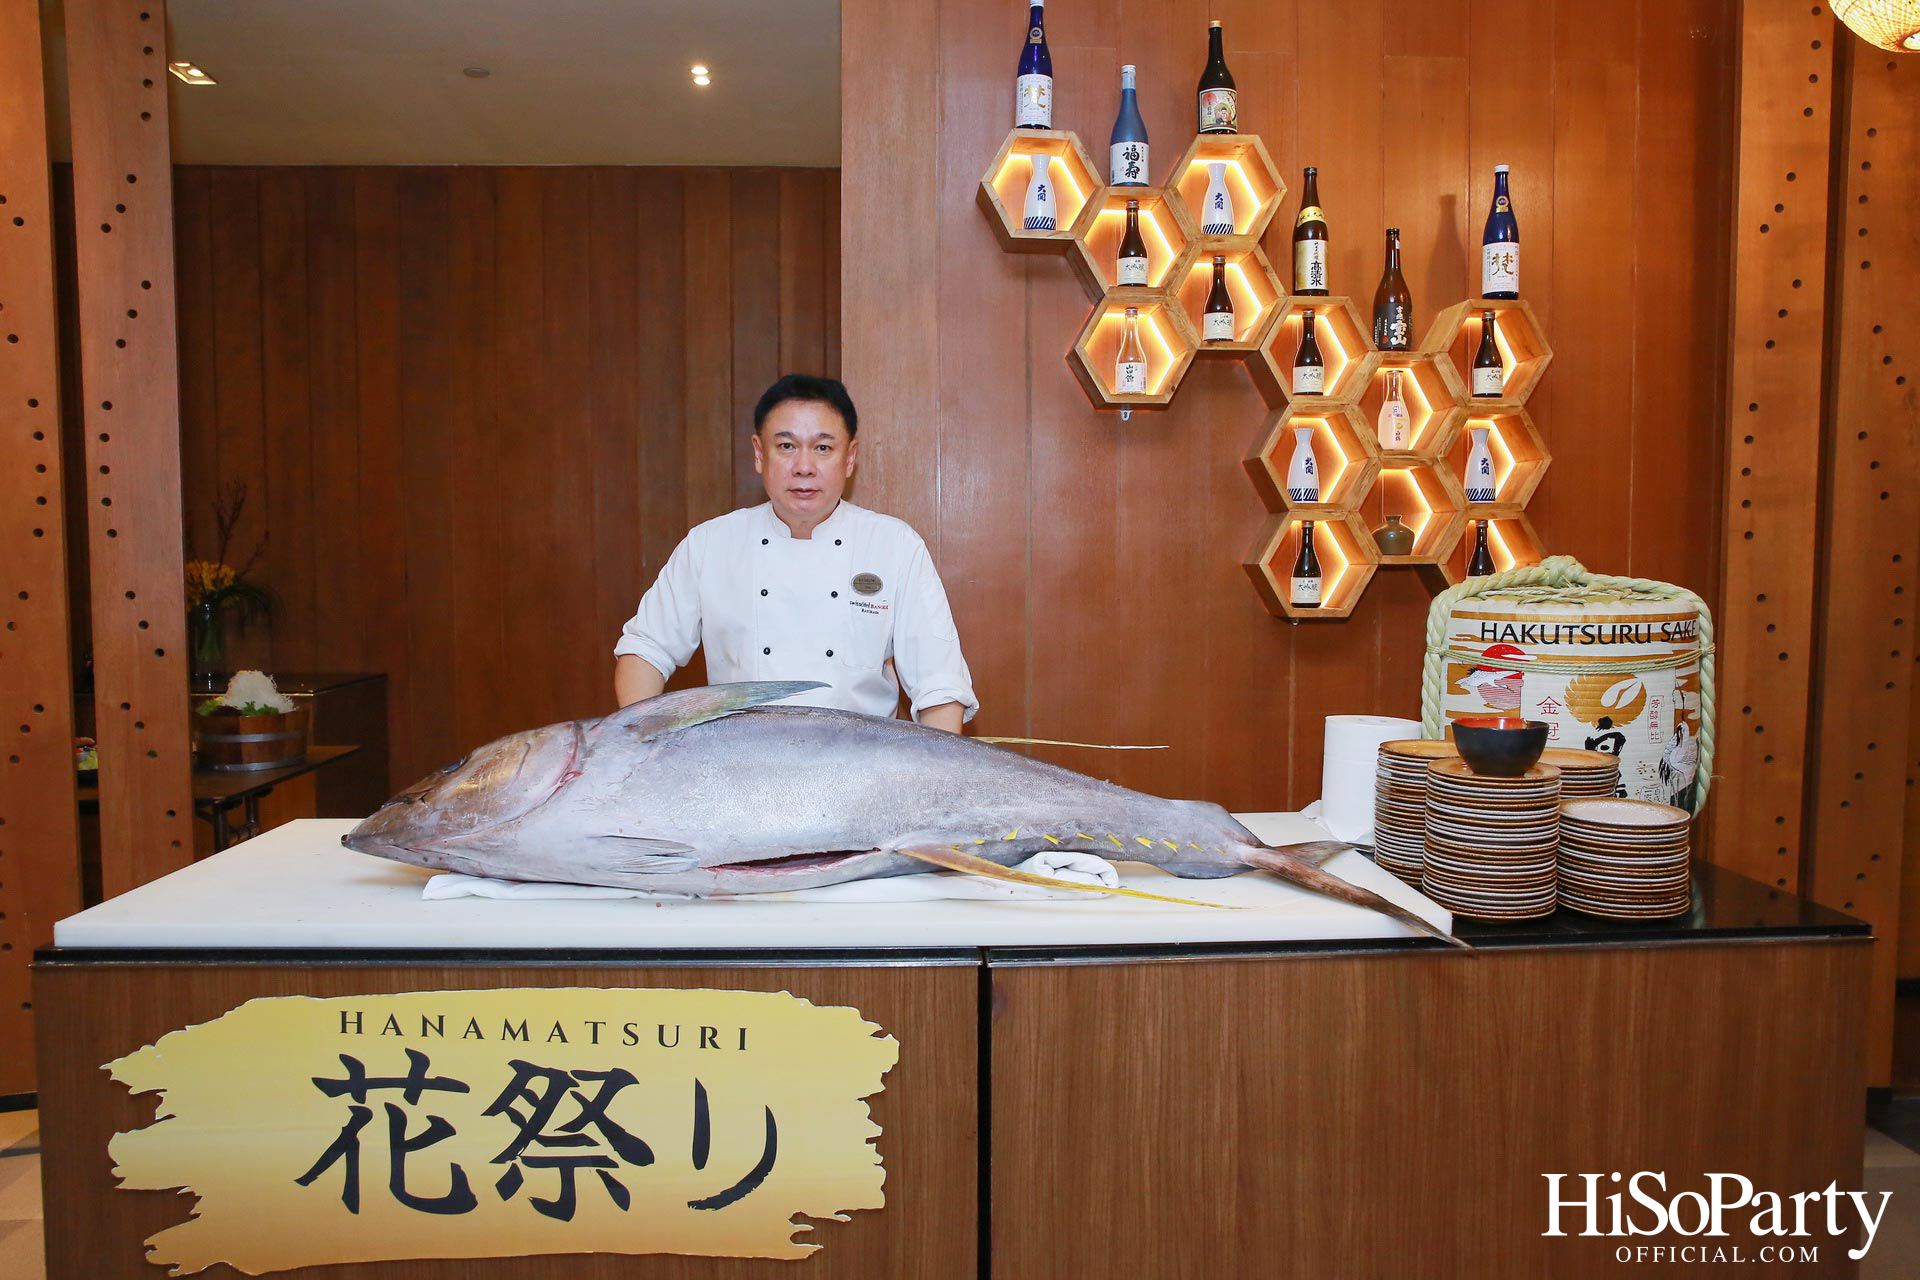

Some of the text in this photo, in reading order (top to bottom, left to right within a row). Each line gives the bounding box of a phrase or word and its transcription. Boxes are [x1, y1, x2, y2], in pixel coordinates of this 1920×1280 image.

[1481, 619, 1697, 645] HAKUTSURU SAKE
[339, 1010, 748, 1051] HANAMATSURI
[294, 1047, 777, 1222] 花祭り
